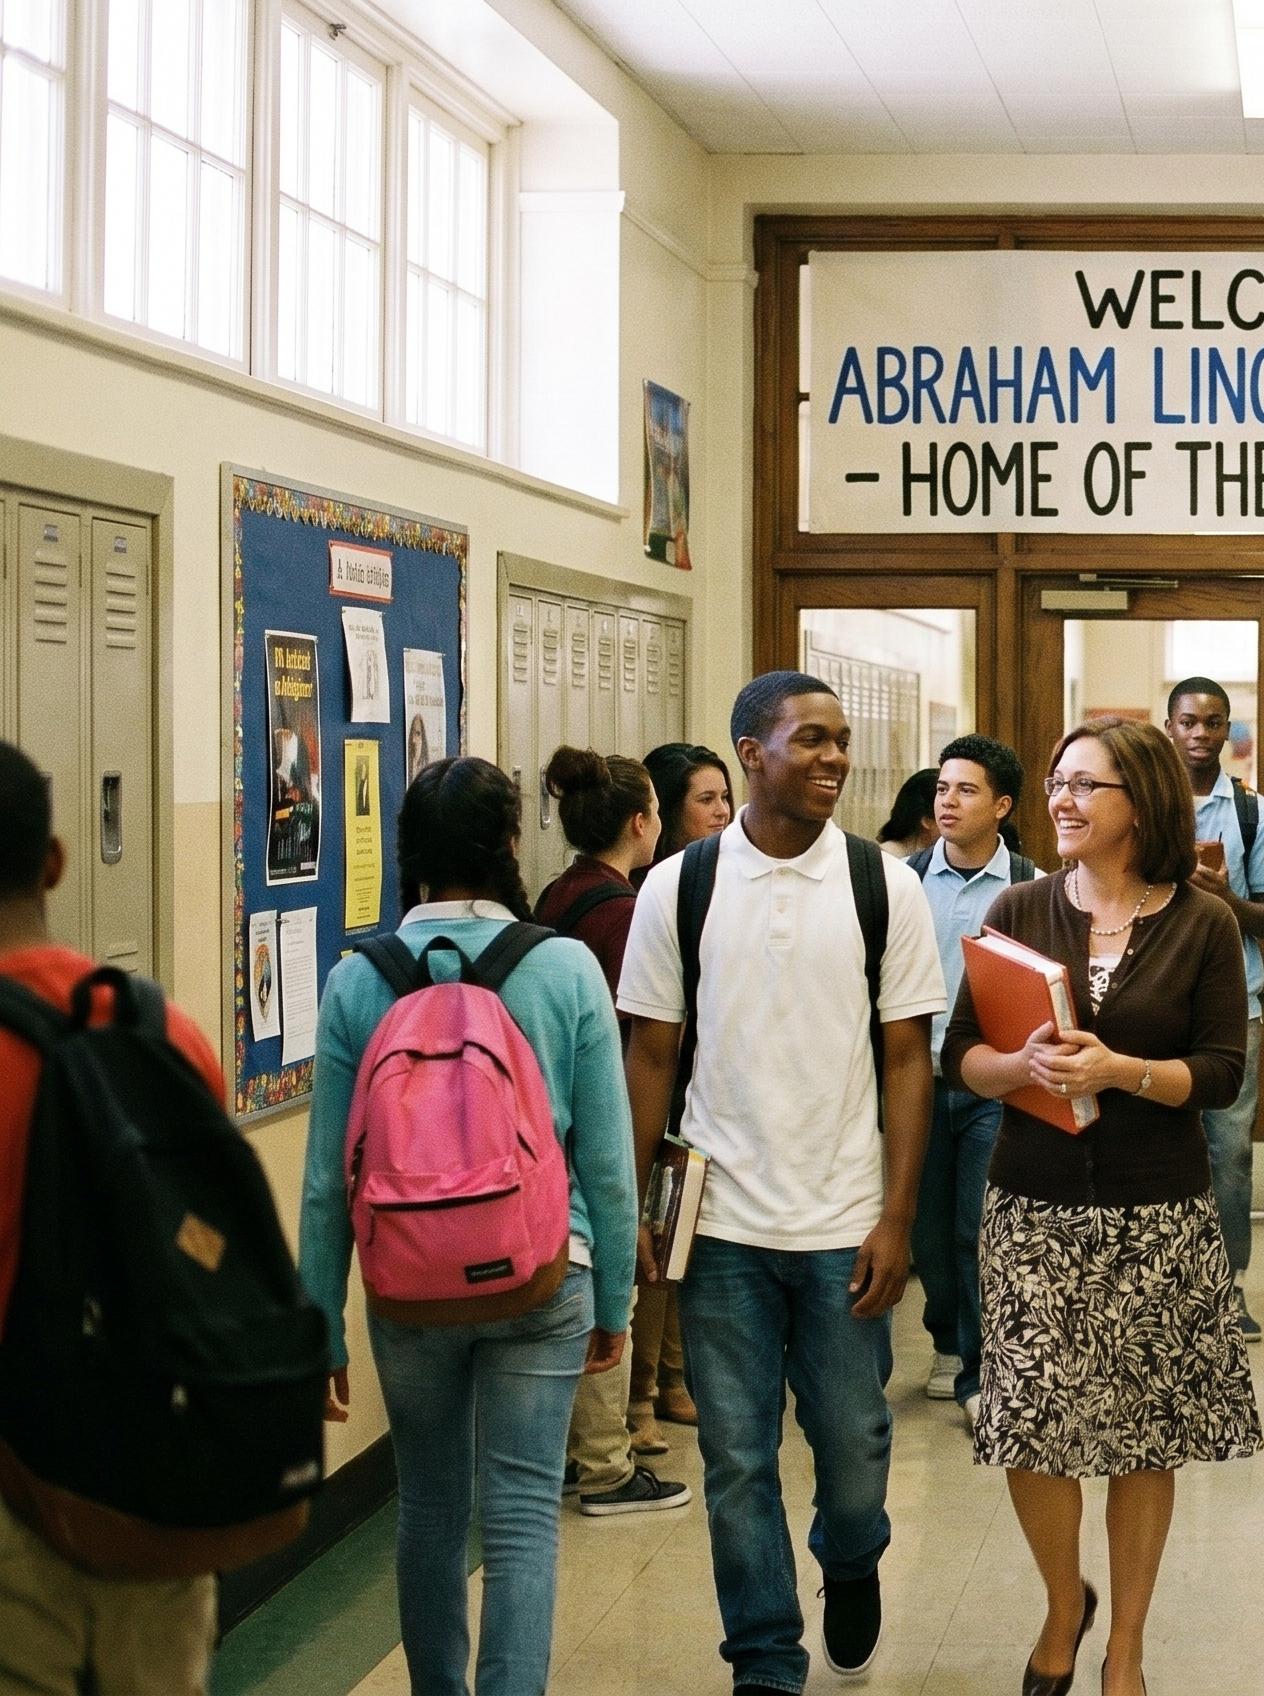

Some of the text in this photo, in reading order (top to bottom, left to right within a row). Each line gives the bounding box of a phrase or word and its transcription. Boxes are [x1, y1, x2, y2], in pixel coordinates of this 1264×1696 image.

[829, 346, 1116, 425] ABRAHAM
[902, 441, 1059, 517] HOME
[1083, 441, 1152, 517] OF
